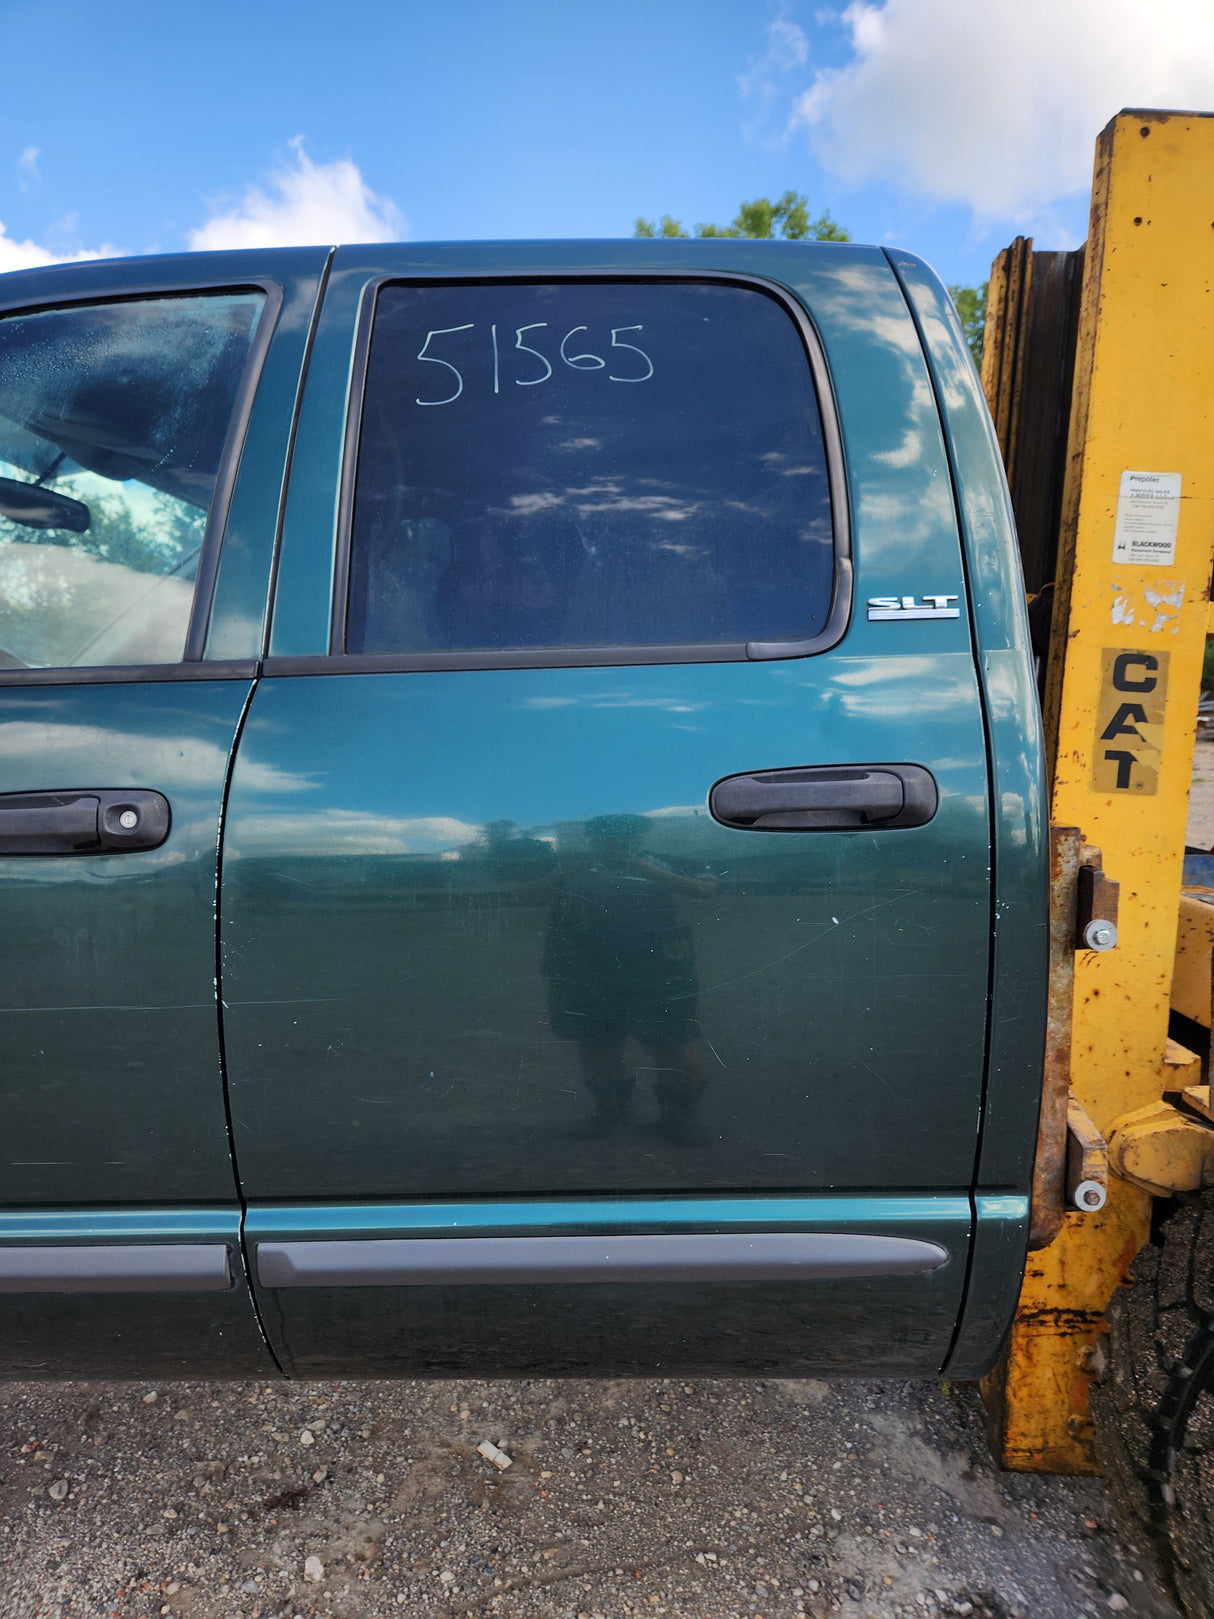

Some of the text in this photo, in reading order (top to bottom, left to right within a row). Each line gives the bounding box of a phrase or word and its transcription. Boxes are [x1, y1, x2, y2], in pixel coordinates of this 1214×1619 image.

[416, 322, 654, 406] 51565
[1131, 540, 1172, 548] BLACKWOOD
[868, 595, 959, 610] SLT
[1100, 653, 1158, 789] CAT
